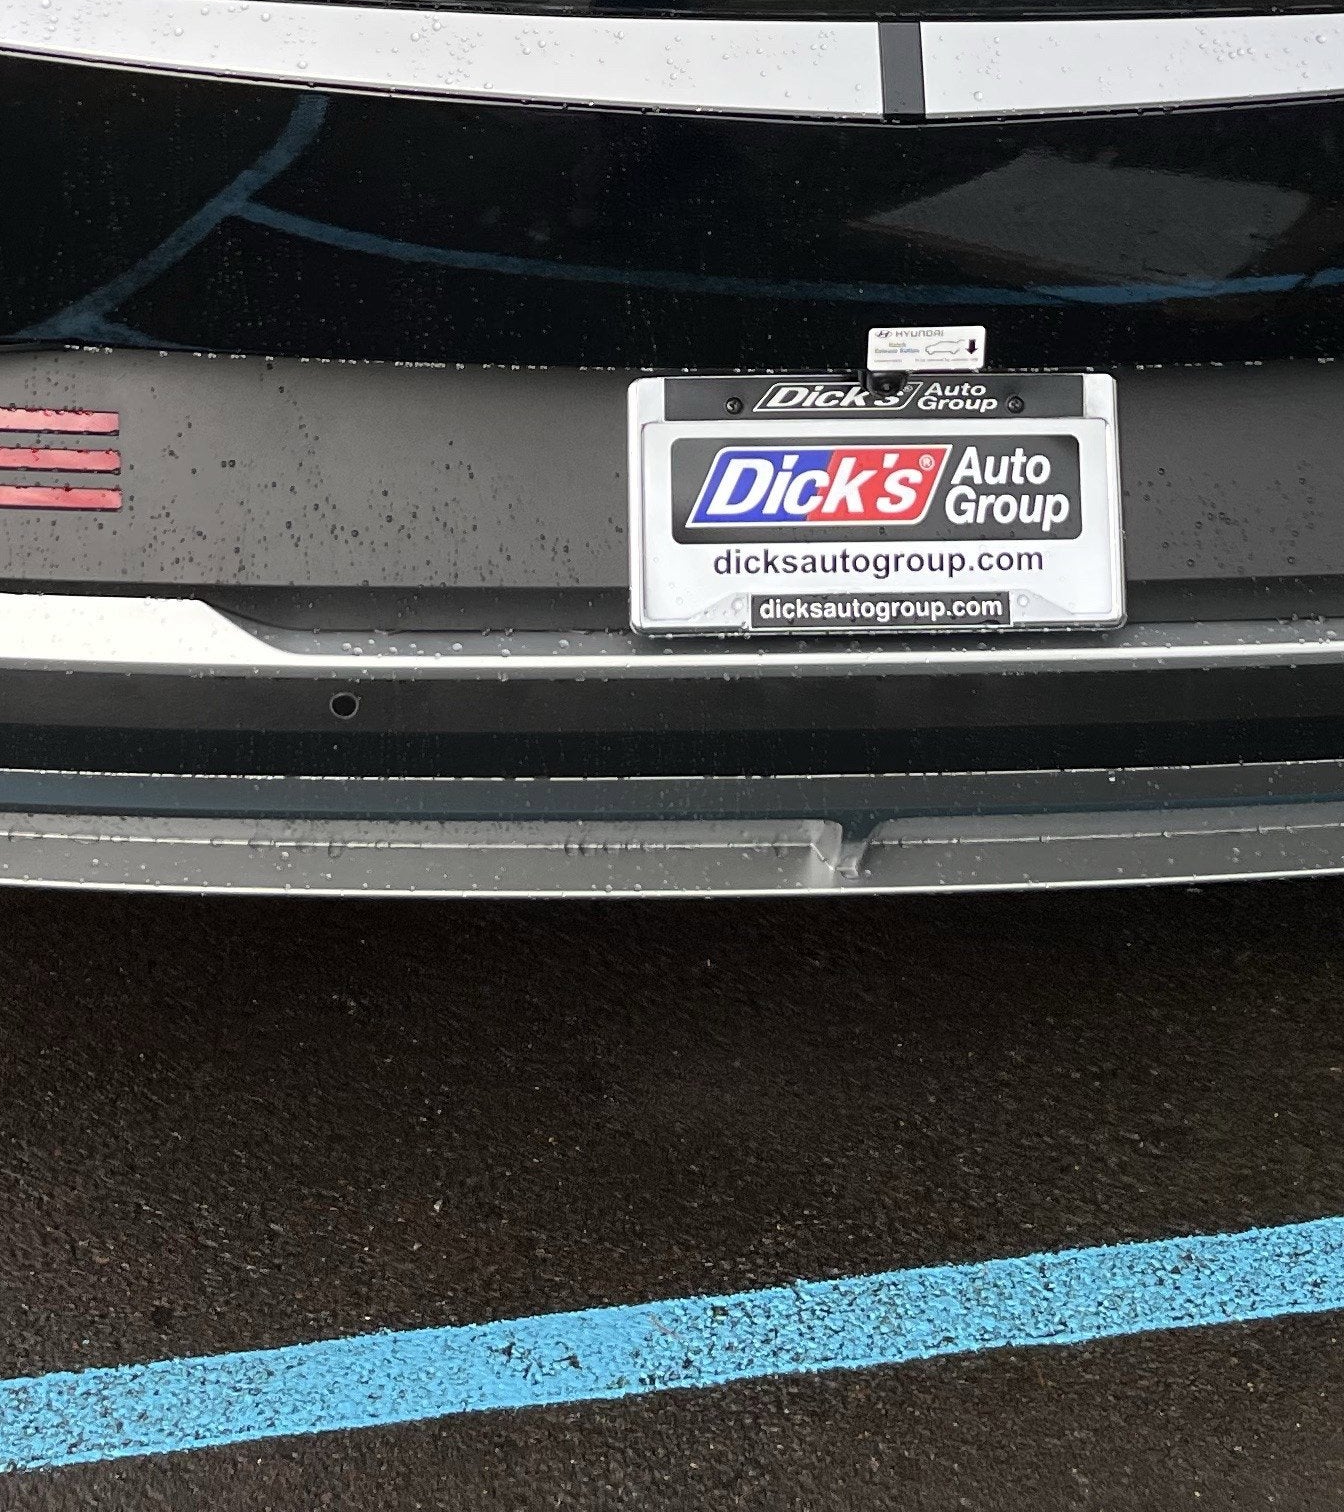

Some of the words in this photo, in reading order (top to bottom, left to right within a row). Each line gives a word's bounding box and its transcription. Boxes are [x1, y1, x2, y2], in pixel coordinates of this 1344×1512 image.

[766, 385, 905, 408] Dicks
[924, 382, 987, 397] Auto
[917, 396, 998, 413] Group
[951, 447, 1051, 486] Auto
[945, 487, 1069, 532] Group
[713, 548, 1044, 579] dicksautogroup.com
[759, 597, 1003, 622] dicksautogroup.com
